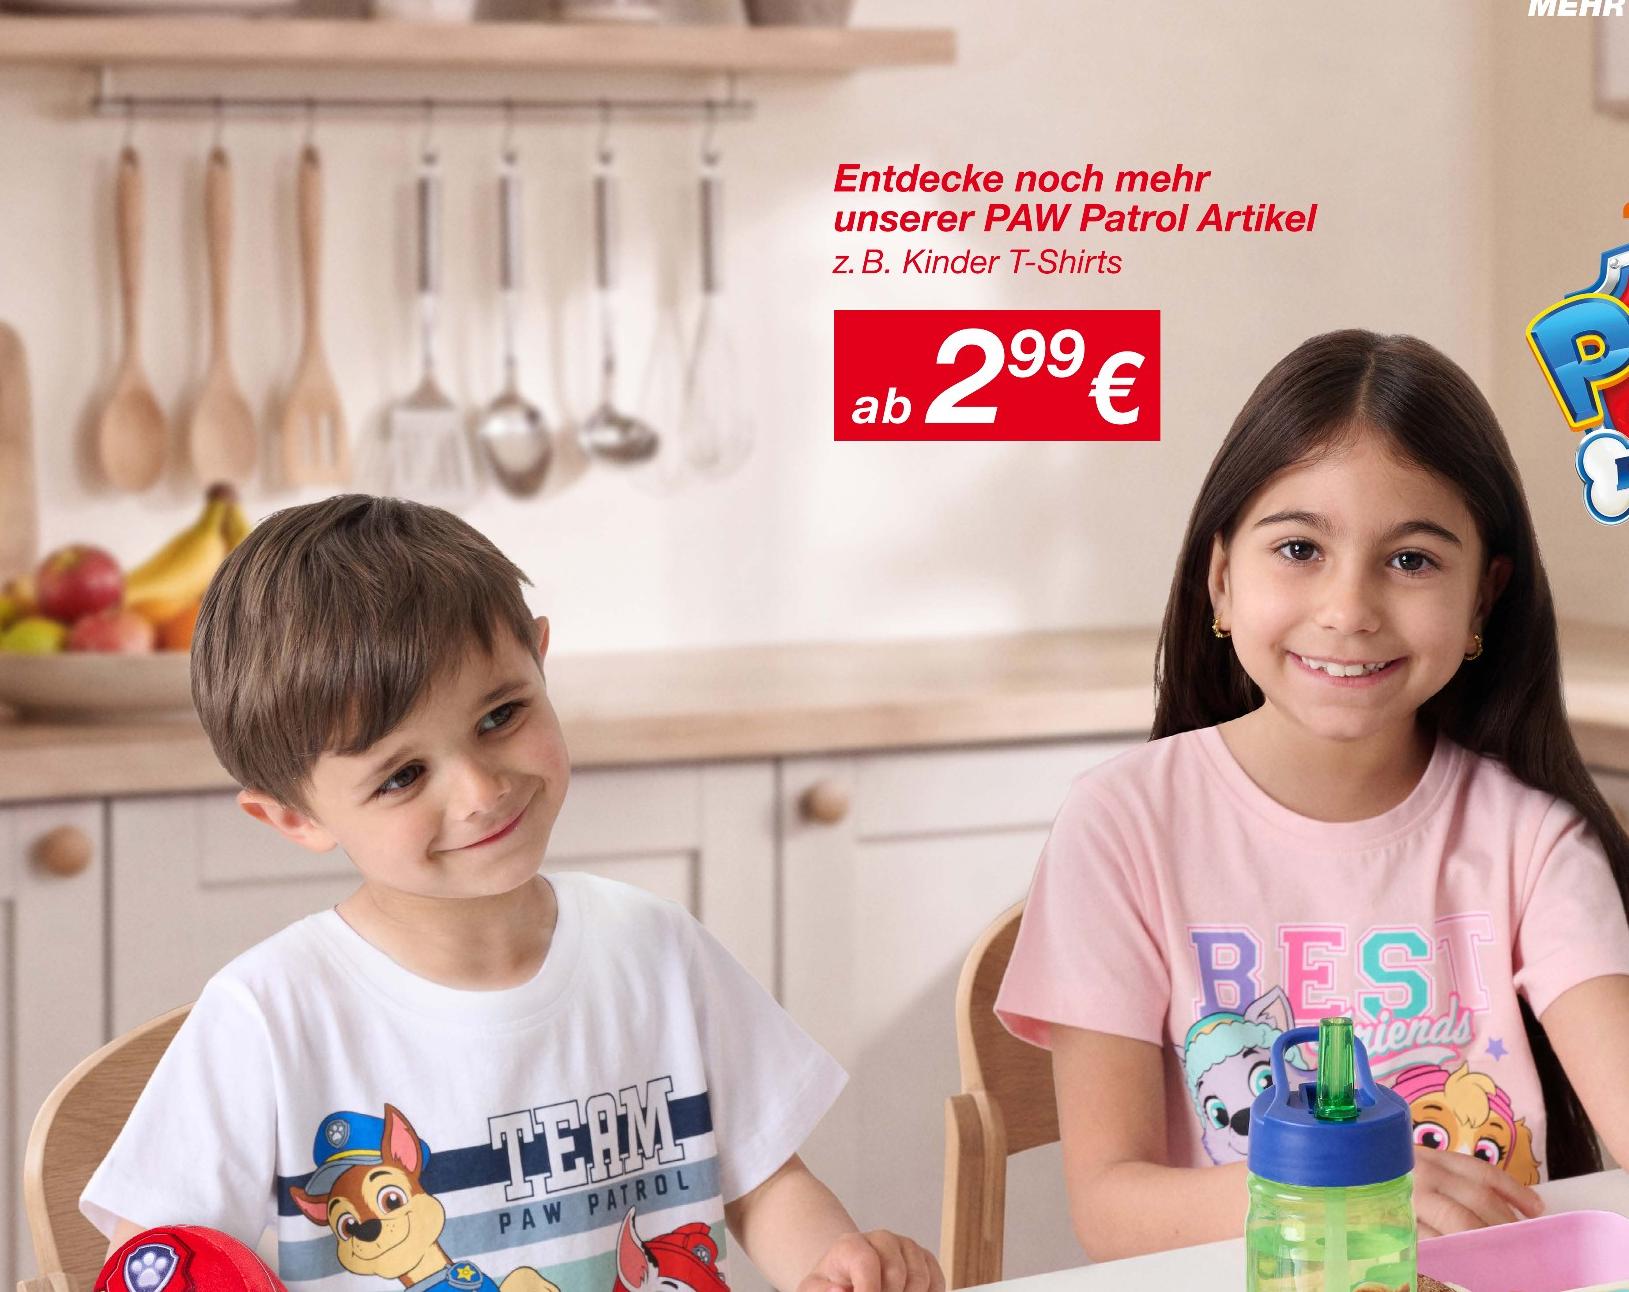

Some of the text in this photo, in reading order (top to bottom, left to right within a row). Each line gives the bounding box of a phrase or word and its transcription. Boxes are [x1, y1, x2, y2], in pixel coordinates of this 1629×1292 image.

[1186, 912, 1495, 1022] BEST
[1340, 992, 1475, 1058] riends
[487, 1074, 686, 1202] TEAM
[498, 1169, 691, 1235] PAW PATROL
